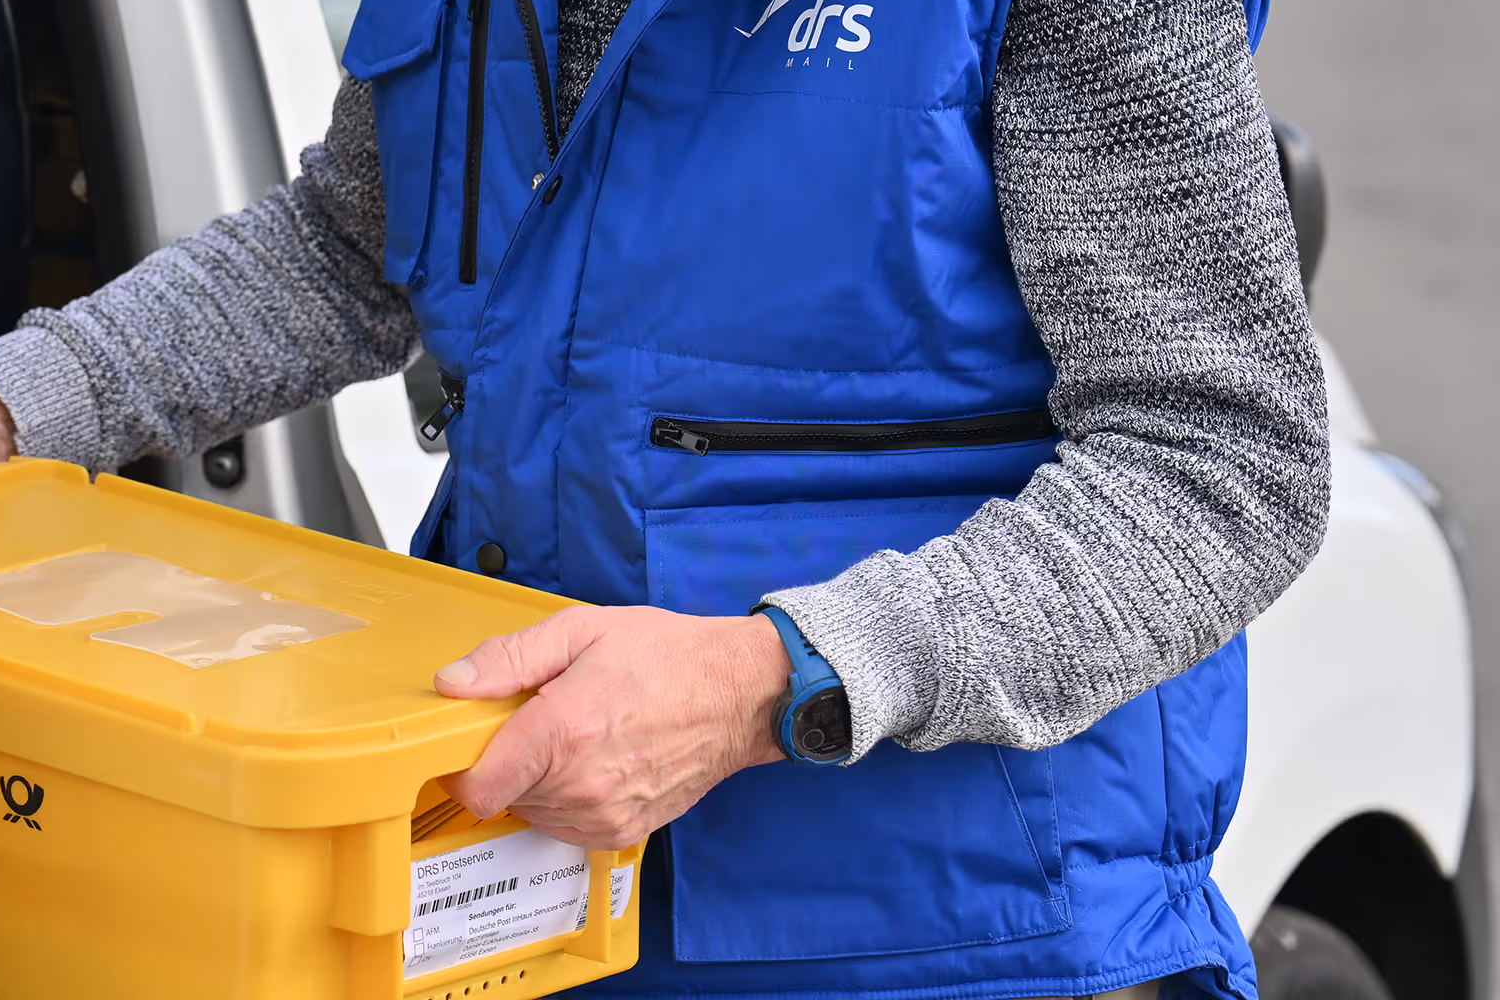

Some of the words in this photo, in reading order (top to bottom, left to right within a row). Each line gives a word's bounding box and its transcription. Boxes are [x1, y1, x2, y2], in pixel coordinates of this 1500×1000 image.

[785, 56, 855, 71] MAIL
[417, 863, 439, 879] DRS
[441, 850, 494, 872] Postservice
[528, 872, 550, 887] KST
[551, 863, 585, 881] 000884
[434, 885, 452, 895] Essen
[468, 906, 504, 921] Sendungen
[505, 902, 517, 912] für:
[468, 921, 496, 935] Deutsche
[497, 917, 511, 927] Post
[534, 904, 561, 917] Services
[559, 897, 579, 909] GmbH
[427, 935, 463, 950] Frankierung
